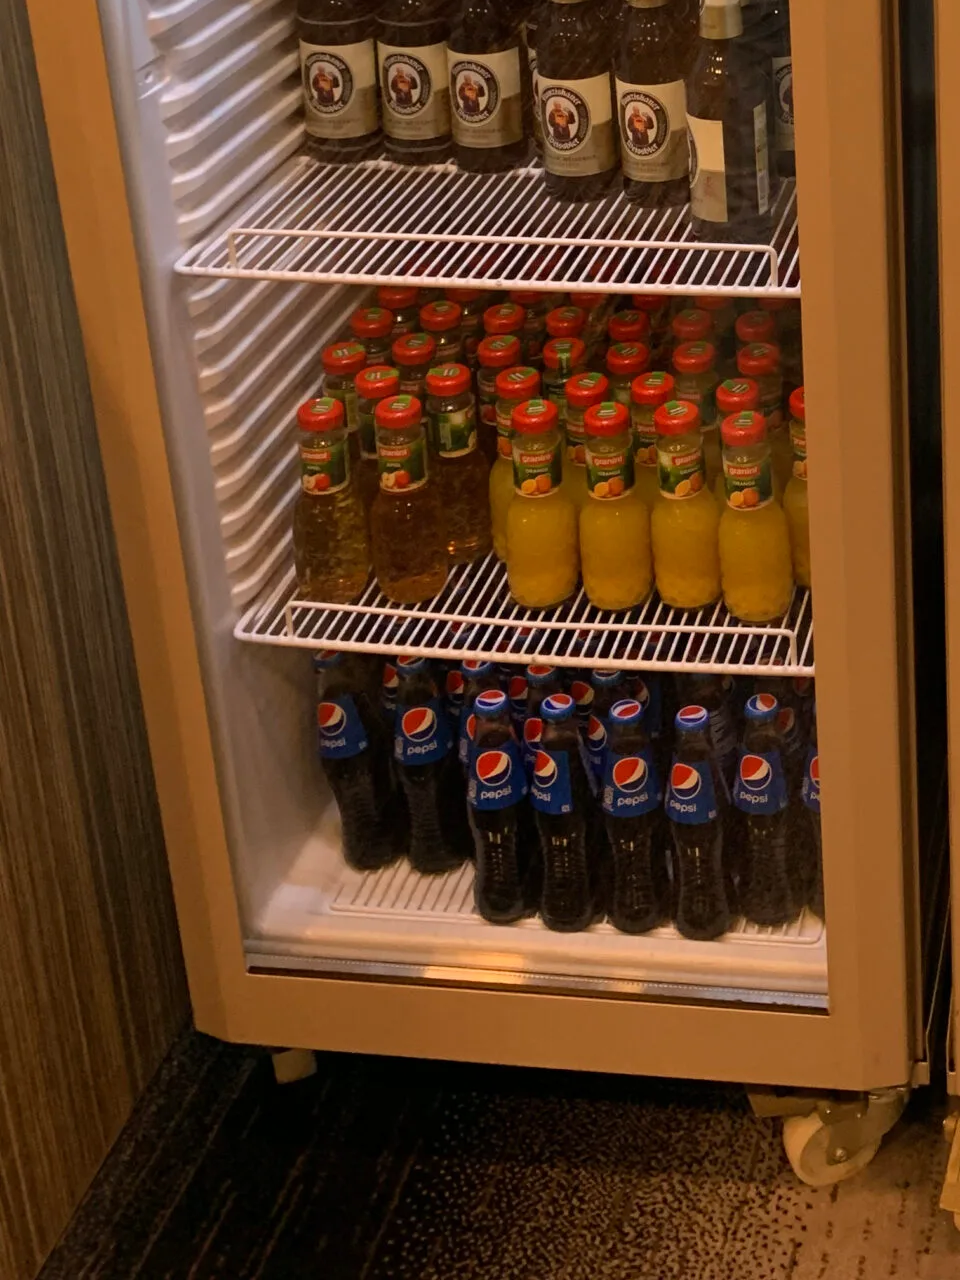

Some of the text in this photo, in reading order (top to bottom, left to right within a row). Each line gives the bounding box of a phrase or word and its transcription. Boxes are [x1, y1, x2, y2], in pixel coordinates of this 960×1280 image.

[728, 466, 758, 476] granini
[407, 740, 438, 756] pepsi
[481, 785, 512, 801] pepsi
[616, 793, 649, 808] pepsi
[740, 790, 769, 805] pepsi
[669, 799, 698, 814] pepsi
